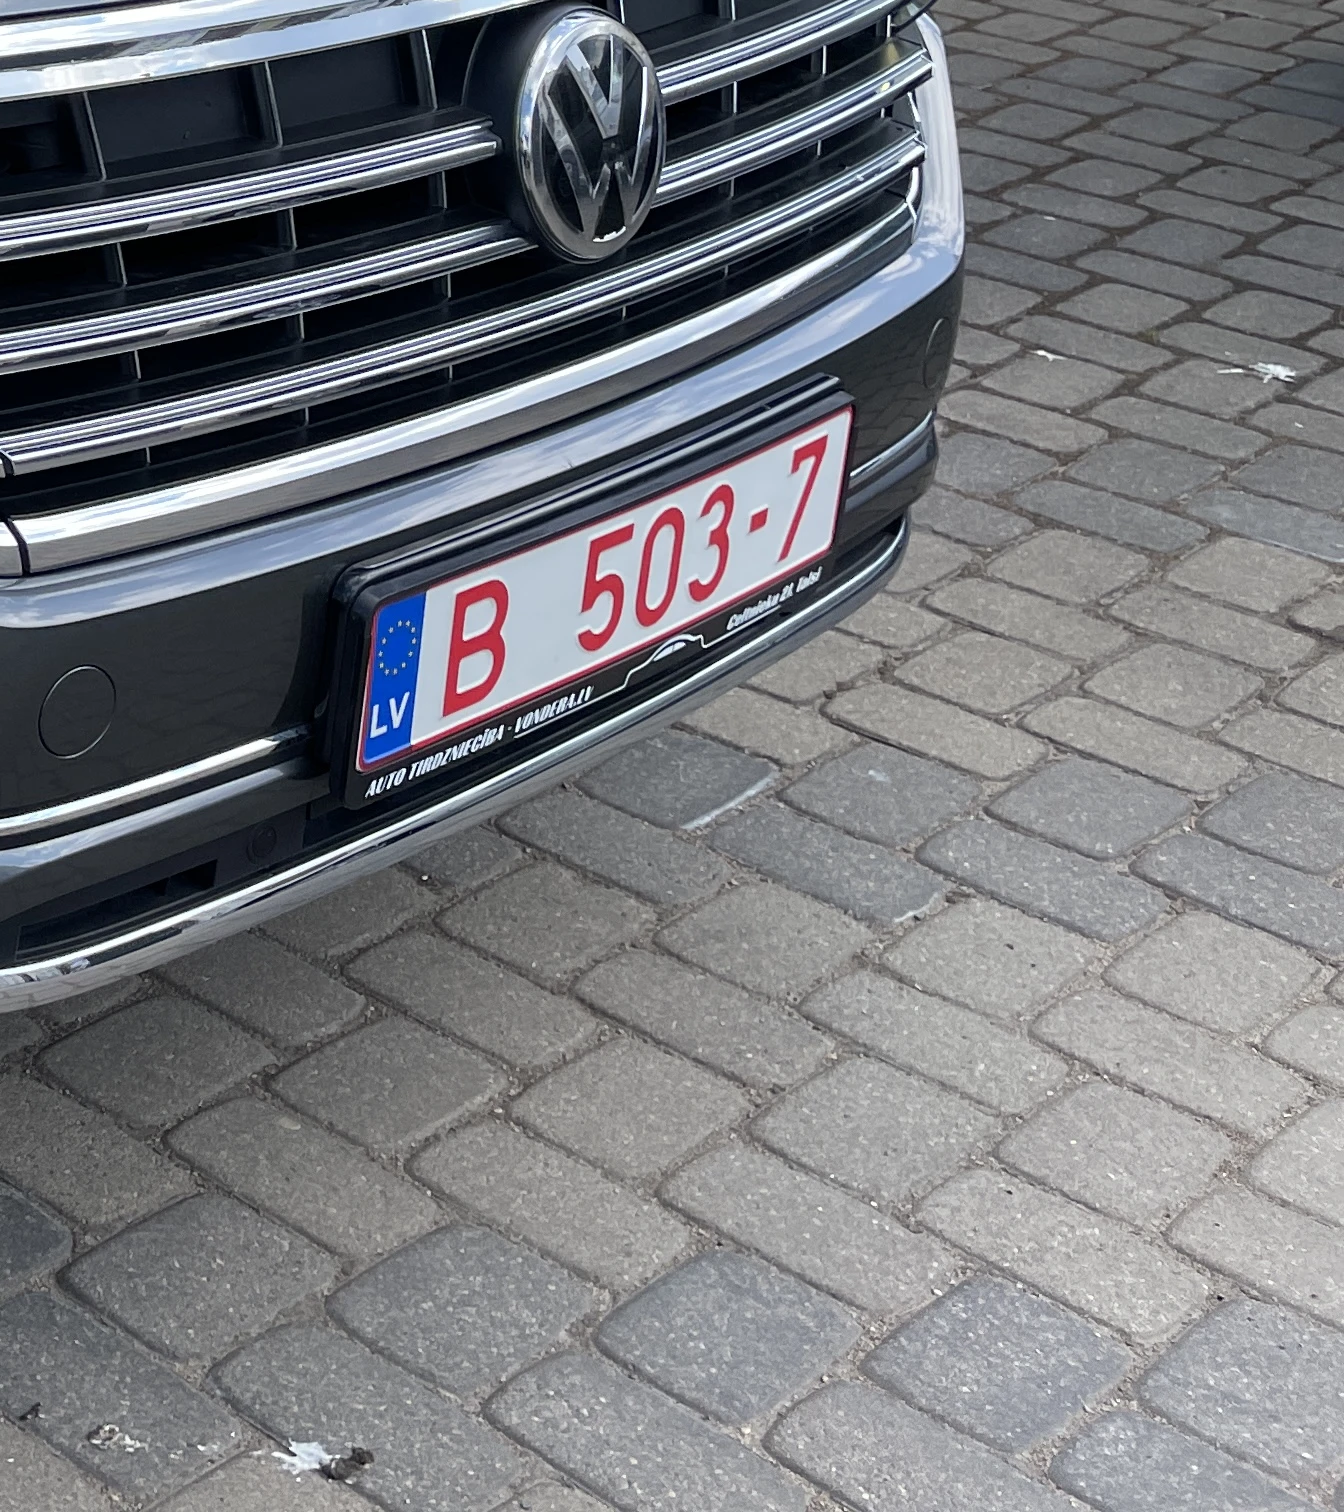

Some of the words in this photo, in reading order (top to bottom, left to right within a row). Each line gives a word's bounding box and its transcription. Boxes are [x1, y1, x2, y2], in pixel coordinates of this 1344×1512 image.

[369, 691, 411, 739] LV
[442, 578, 511, 718] B
[577, 433, 829, 653] 503-7
[364, 766, 409, 799] AUTO
[514, 684, 595, 734] VONDERA.LV
